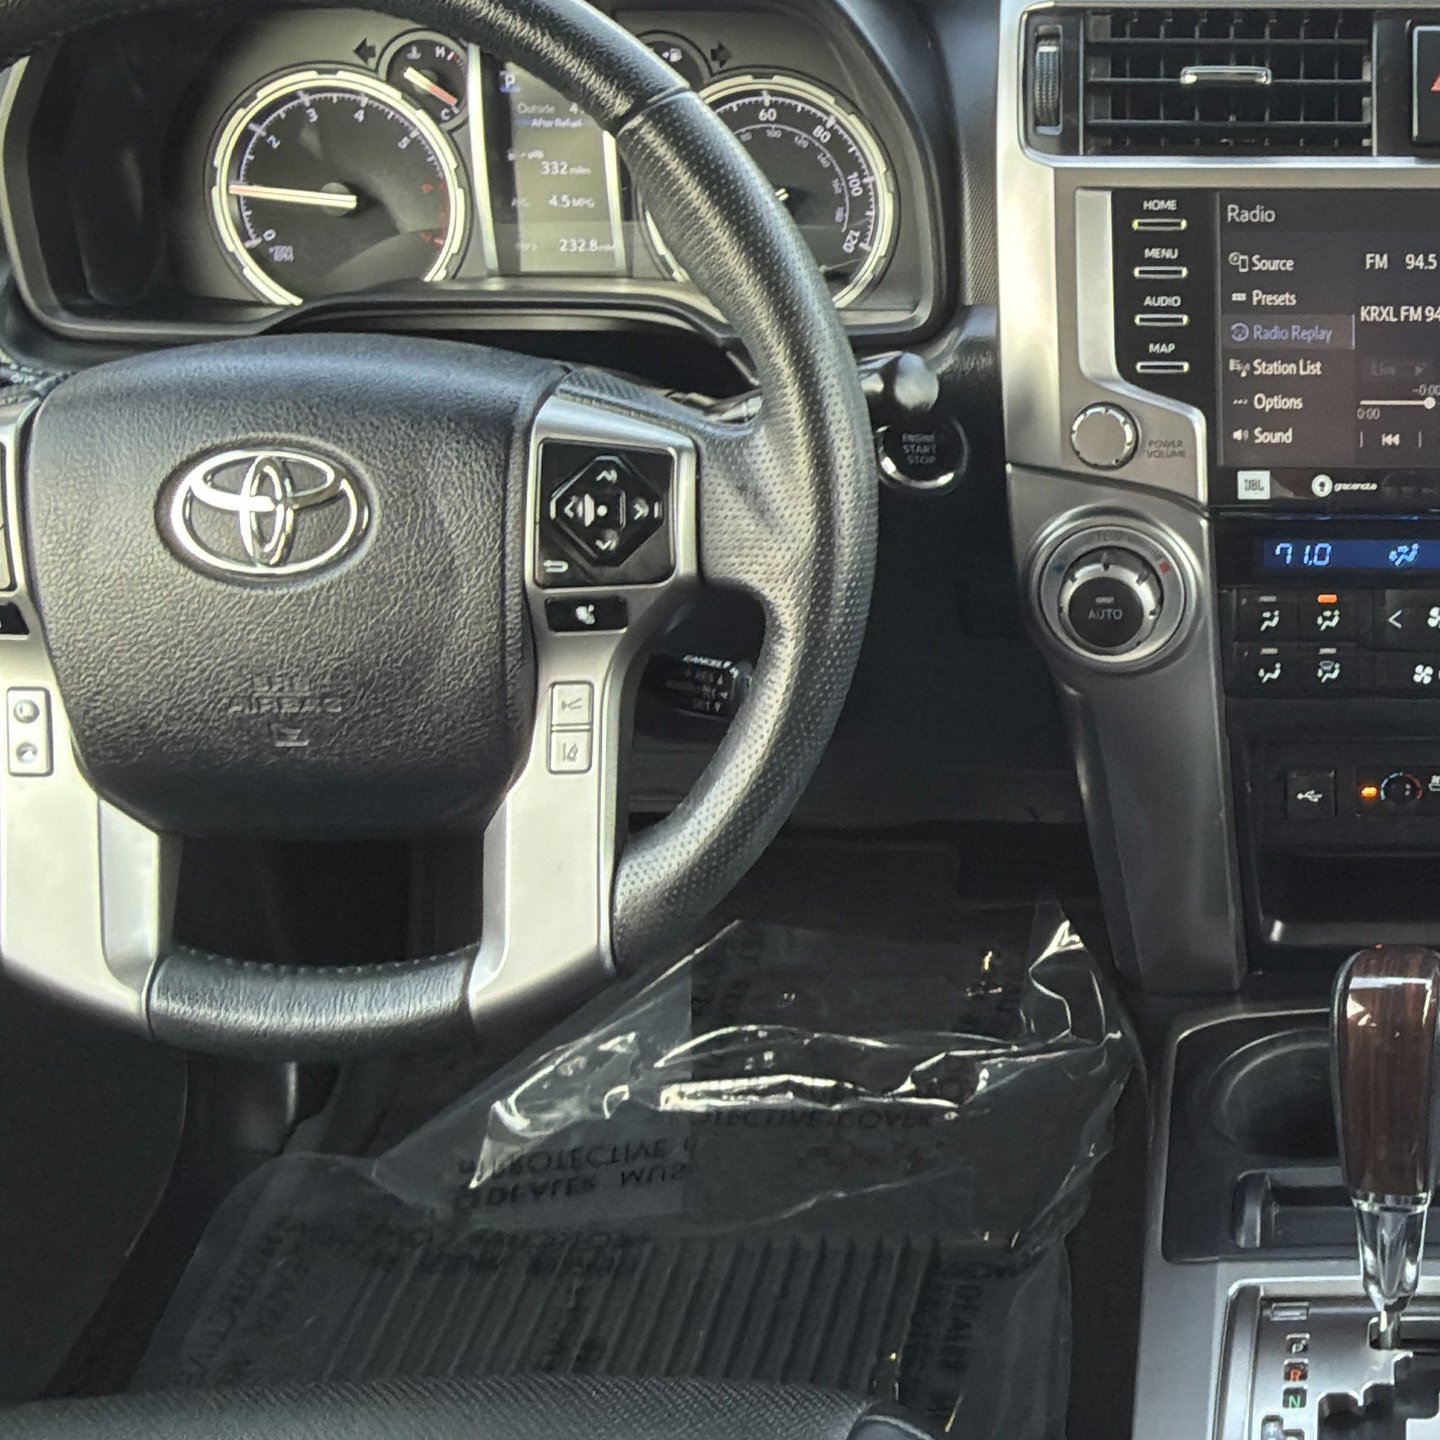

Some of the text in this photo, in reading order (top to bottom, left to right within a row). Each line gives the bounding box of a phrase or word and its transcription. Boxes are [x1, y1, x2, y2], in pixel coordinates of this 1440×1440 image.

[435, 46, 445, 58] H
[307, 109, 318, 123] 3
[354, 109, 365, 122] 4
[440, 107, 451, 121] C
[758, 108, 777, 122] 60
[811, 124, 832, 143] 80
[540, 161, 568, 175] 332
[846, 171, 863, 197] 100
[548, 194, 571, 208] 4.5
[1143, 200, 1177, 210] HOME
[1227, 204, 1275, 223] Radio
[559, 238, 599, 252] 232.8
[842, 229, 861, 253] 120
[1145, 248, 1178, 259] MENU
[1252, 255, 1294, 271] Source
[1365, 254, 1388, 269] FM
[1405, 254, 1437, 270] 94.5
[1144, 296, 1181, 307] AUDIO
[1252, 290, 1297, 306] Presets
[1360, 306, 1398, 322] KRXL
[1400, 306, 1422, 322] FM
[1253, 326, 1332, 344] Radio Replay
[1149, 343, 1176, 354] MAP
[1253, 360, 1322, 375] Station List
[1253, 394, 1303, 413] Options
[1254, 427, 1293, 444] Sound
[902, 444, 937, 454] START
[1148, 440, 1183, 449] POWER
[1088, 609, 1123, 621] AUTO
[1291, 1340, 1306, 1354] P
[1290, 1368, 1302, 1381] R
[1288, 1394, 1301, 1408] N
